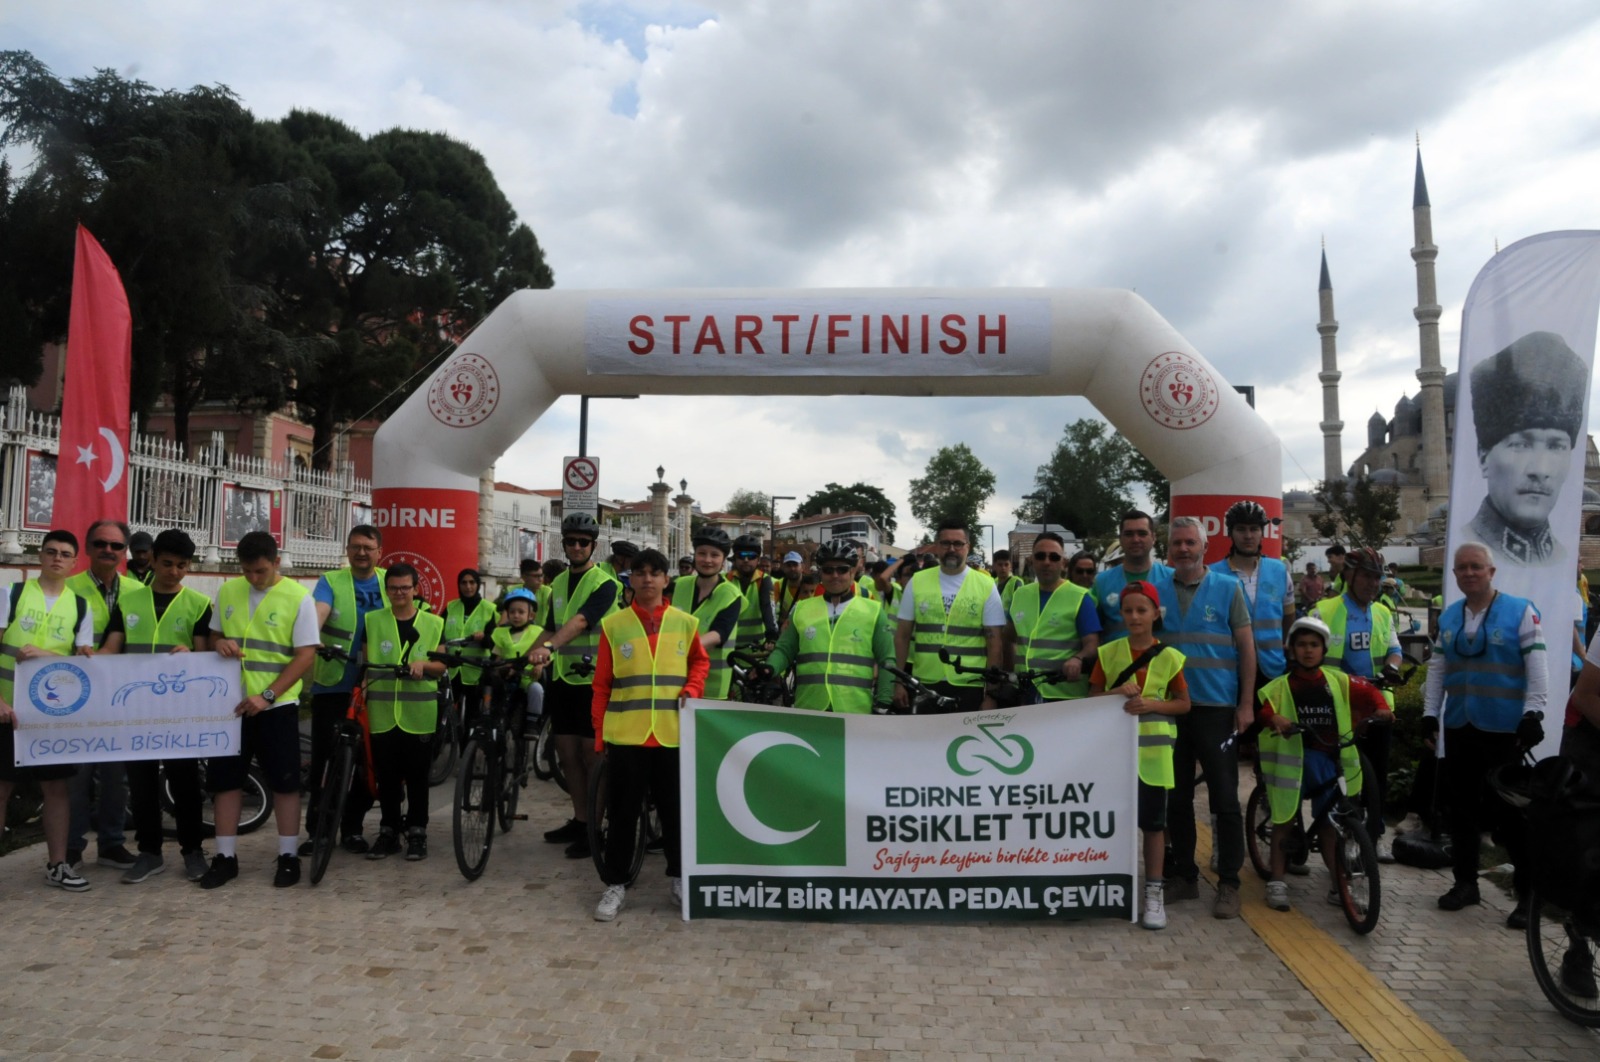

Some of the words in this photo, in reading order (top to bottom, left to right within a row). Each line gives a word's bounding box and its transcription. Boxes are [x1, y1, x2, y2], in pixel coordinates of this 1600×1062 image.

[627, 313, 1007, 356] START/FINISH
[371, 502, 456, 529] EDİRNE
[30, 737, 122, 759] (SOSYAL
[885, 786, 982, 808] EDİRNE
[988, 782, 1095, 810] YEŞİLAY
[866, 814, 1013, 842] BİSİKLET
[1022, 810, 1115, 840] TURU
[873, 847, 937, 872] Sağlığın
[940, 848, 993, 872] keyfini
[996, 847, 1050, 864] birlikte
[1052, 847, 1110, 864] sürelim
[699, 880, 782, 908] TEMİZ
[788, 882, 834, 910] BİR
[838, 887, 944, 910] HAYATA
[948, 886, 1039, 910] PEDAL
[1043, 879, 1125, 916] ÇEVİR
